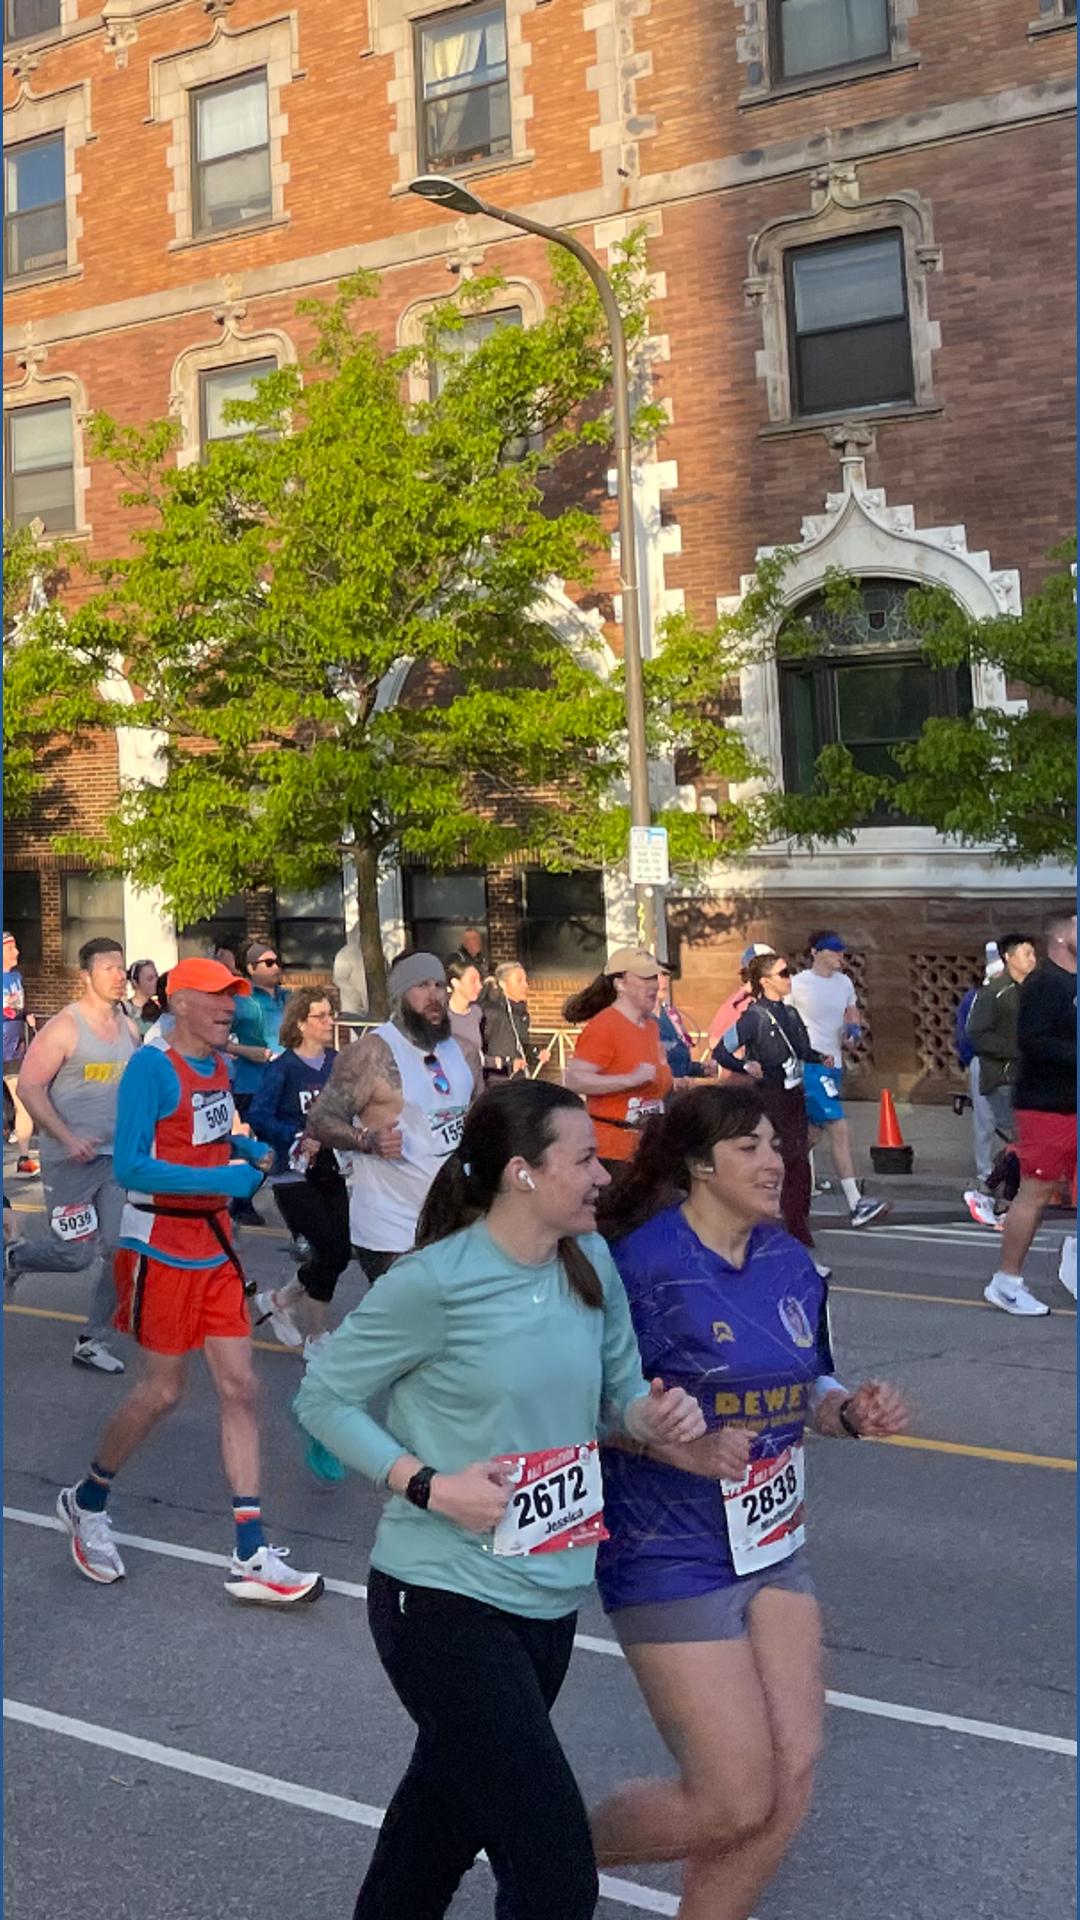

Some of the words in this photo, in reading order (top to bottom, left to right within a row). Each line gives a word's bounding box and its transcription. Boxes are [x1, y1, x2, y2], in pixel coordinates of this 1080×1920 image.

[206, 1104, 228, 1128] 500
[59, 1212, 92, 1232] 5039
[513, 1466, 587, 1529] 2672
[742, 1465, 797, 1526] 2838
[545, 1508, 583, 1534] Jessica
